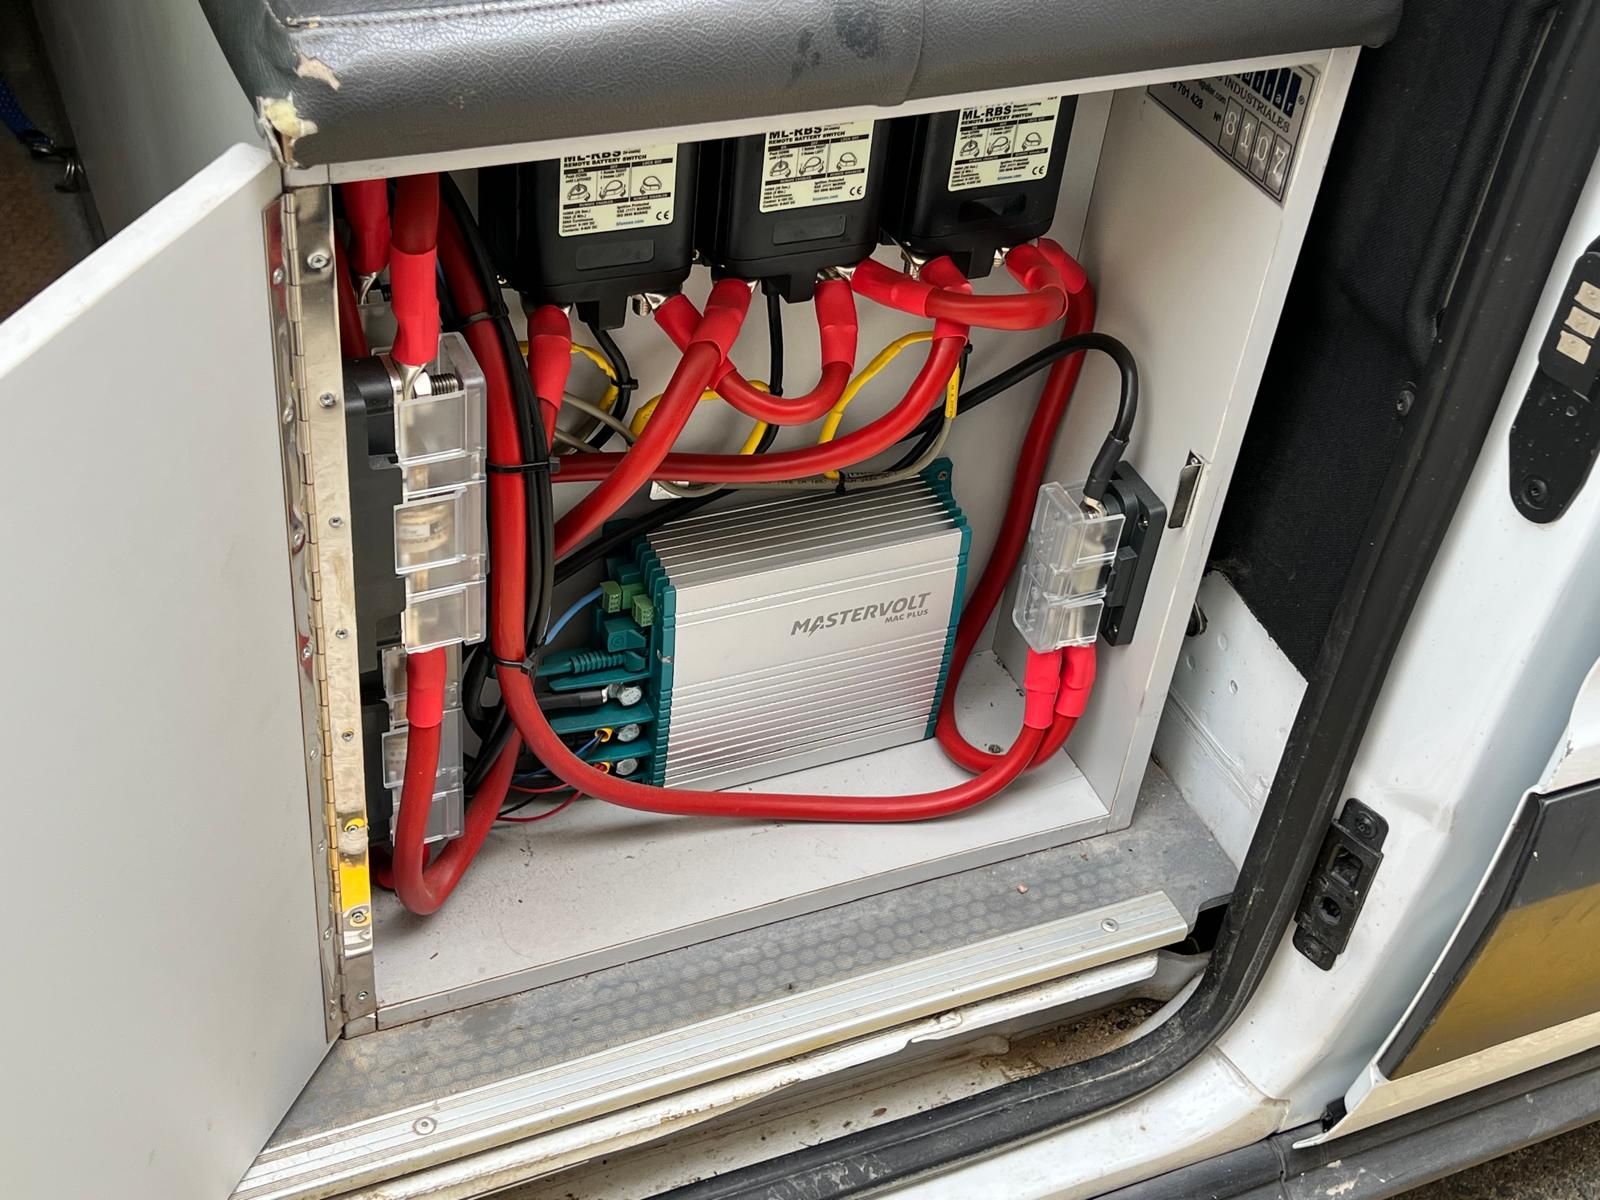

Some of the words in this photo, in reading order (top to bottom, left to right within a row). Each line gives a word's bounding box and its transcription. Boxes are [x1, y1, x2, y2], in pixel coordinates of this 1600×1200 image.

[1224, 76, 1291, 133] INDUSTRIALES
[962, 105, 1012, 121] ML-RBS
[985, 115, 1010, 123] BATTERY
[1011, 112, 1033, 120] SWITCH
[794, 134, 822, 142] BATTERY
[823, 130, 846, 138] SWITCH
[1224, 111, 1287, 175] 8107
[563, 160, 591, 168] REMOTE
[591, 157, 621, 166] BATTERY
[622, 154, 647, 162] SWITCH
[655, 210, 670, 221] CE
[790, 592, 932, 637] MASTERVOLT
[885, 614, 905, 625] MAC
[906, 609, 929, 619] PLUS
